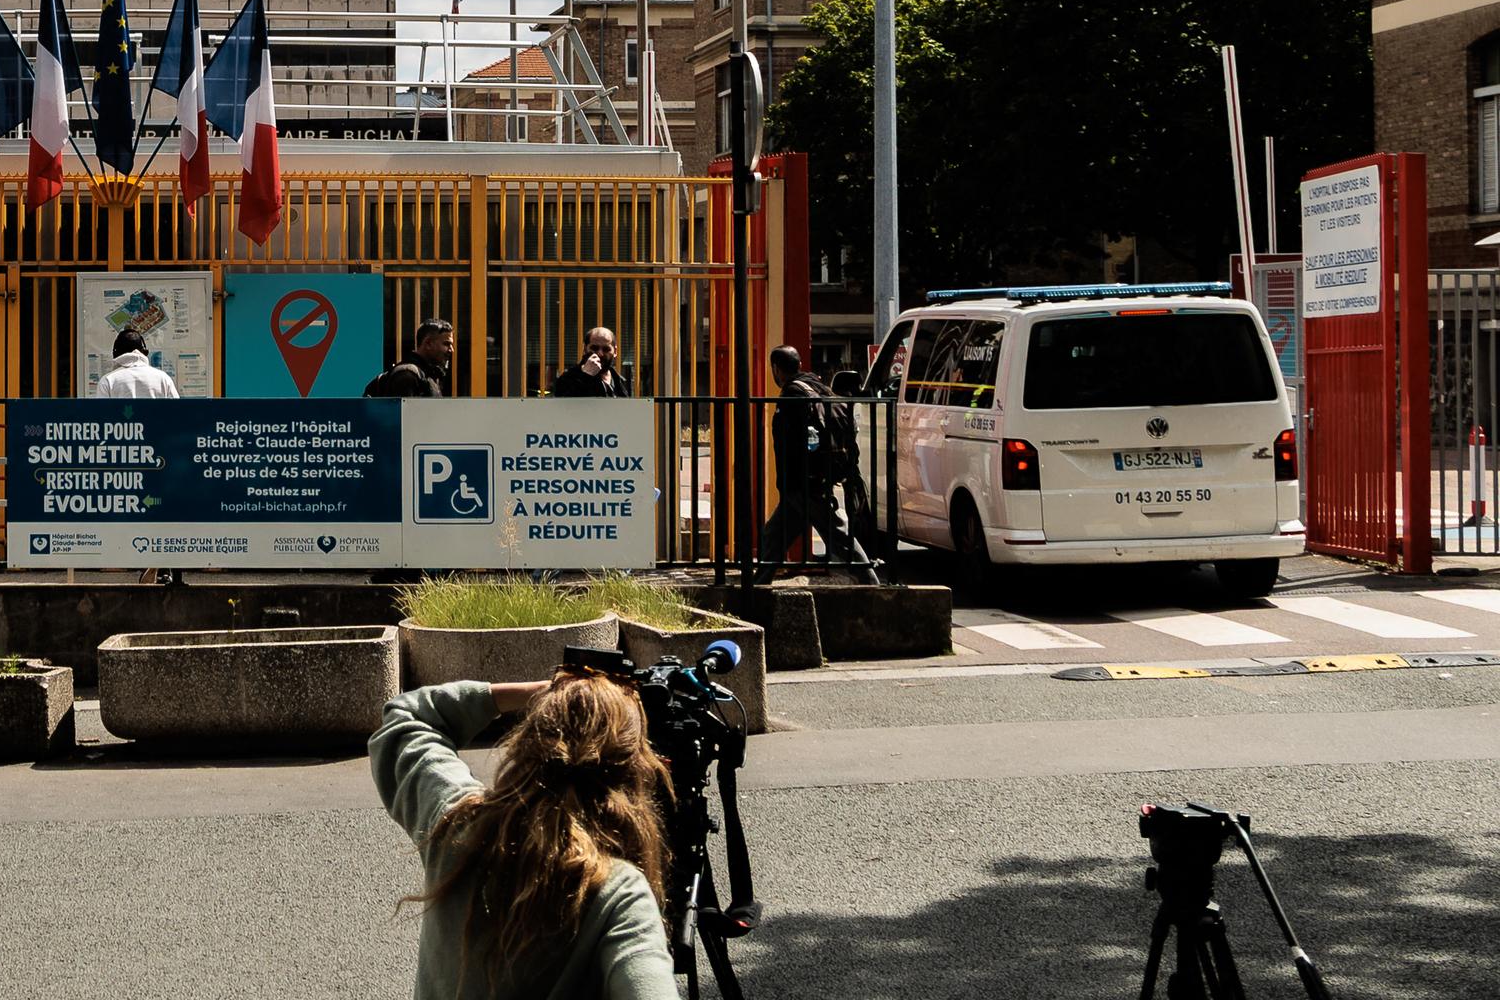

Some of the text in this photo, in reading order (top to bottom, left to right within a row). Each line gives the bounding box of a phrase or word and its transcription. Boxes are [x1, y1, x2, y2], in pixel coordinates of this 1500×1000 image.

[1343, 197, 1353, 210] LES
[1355, 193, 1378, 208] PATIENTS
[1320, 213, 1361, 231] ET LES VISITEURS
[1305, 255, 1317, 268] SAUF
[1318, 253, 1333, 266] POUR
[1335, 251, 1345, 264] LES
[1346, 246, 1378, 263] PERSONNES
[45, 422, 144, 440] ENTRER POUR
[215, 421, 351, 435] Rejoignez l'hôpital
[196, 436, 244, 448] Bichat
[255, 436, 370, 448] Claude-Bernard
[525, 434, 618, 448] PARKING
[28, 441, 161, 467] SON MÉTIER,
[193, 451, 374, 465] et ouvrez-vous les portes
[501, 453, 644, 471] RÉSERVÉ AUX
[46, 471, 144, 490] RESTER POUR
[203, 466, 364, 480] de plus de 45 services.
[423, 453, 453, 494] P
[247, 486, 320, 497] Postulez sur
[510, 479, 635, 494] PERSONNES
[43, 490, 146, 513] ÉVOLUER.
[1115, 489, 1211, 504] 01 43 20 55 50
[220, 501, 347, 513] hopital-bichat.aphp.fr
[512, 498, 632, 516] À MOBILITÉ
[528, 521, 618, 539] RÉDUITE
[215, 536, 248, 545] MÉTIER
[216, 544, 248, 554] ÉQUIPE
[274, 545, 315, 553] PUBLIQUE
